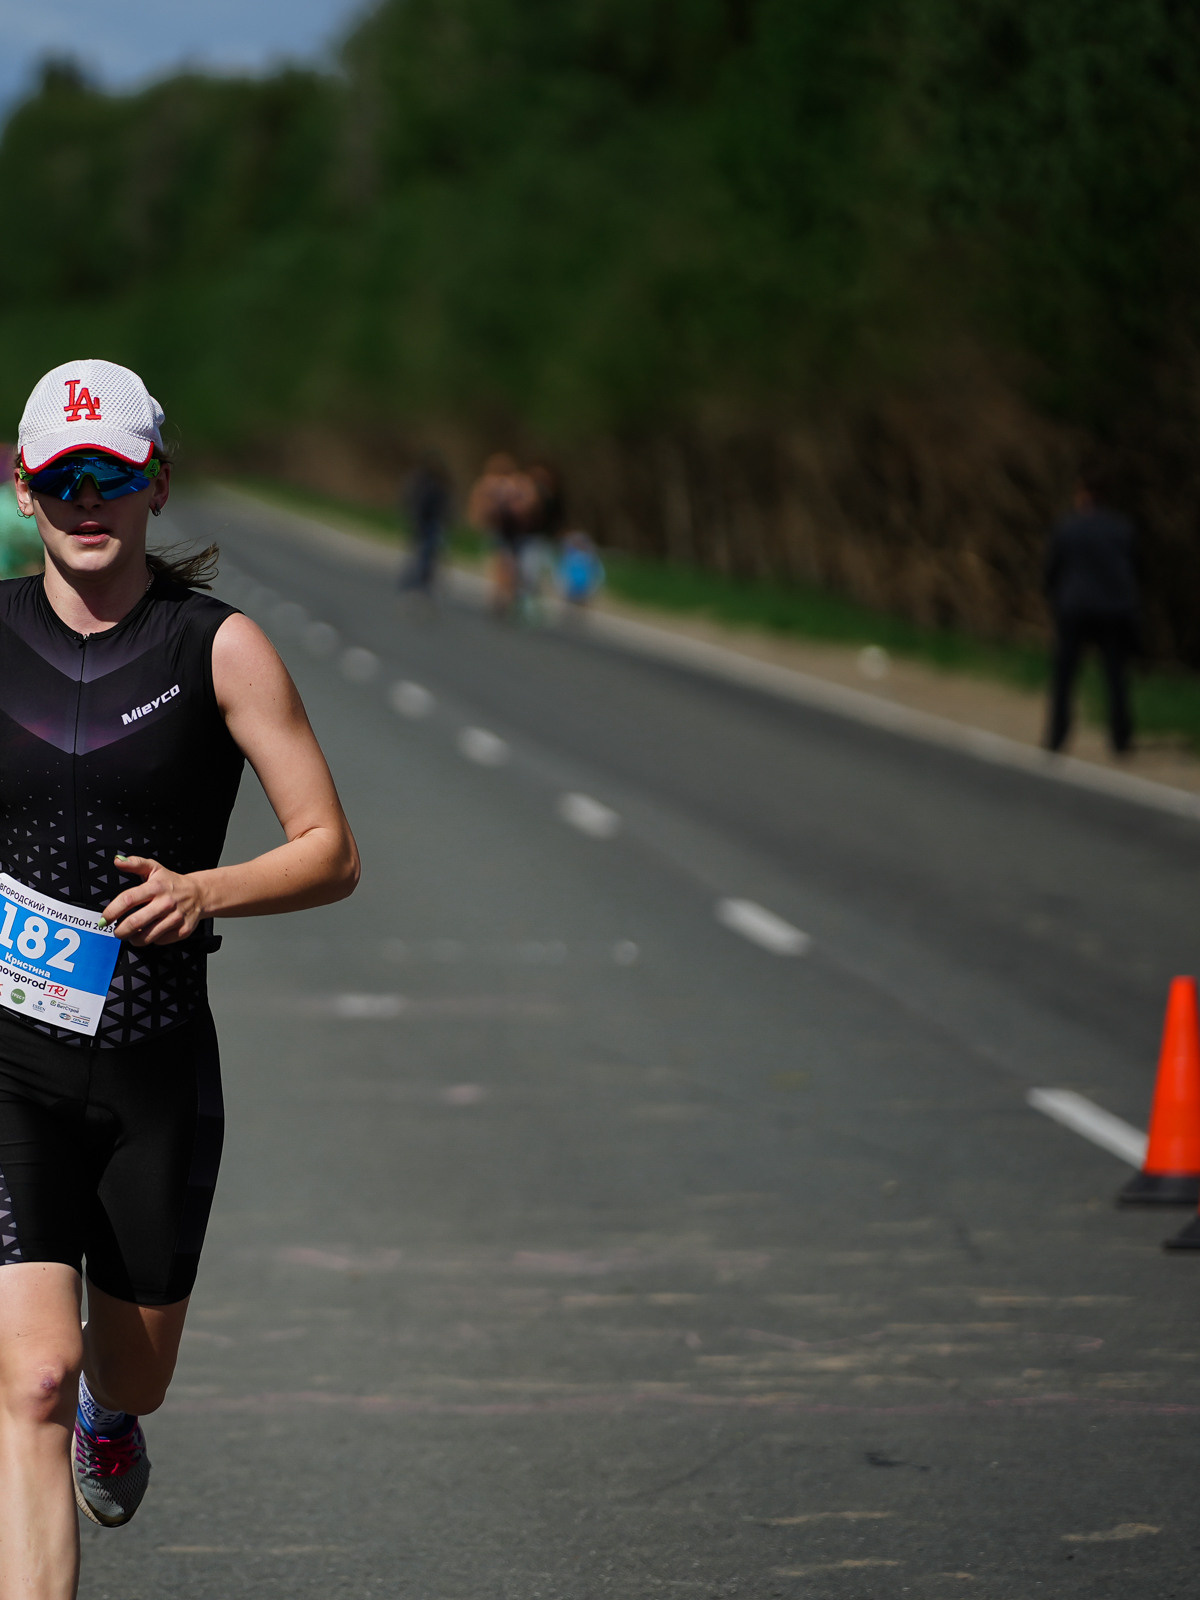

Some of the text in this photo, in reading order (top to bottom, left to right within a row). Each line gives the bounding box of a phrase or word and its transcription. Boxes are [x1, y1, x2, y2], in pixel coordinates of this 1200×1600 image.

[64, 379, 102, 422] LA
[46, 905, 92, 929] ТРИАТЛОН
[4, 951, 51, 979] Кристина
